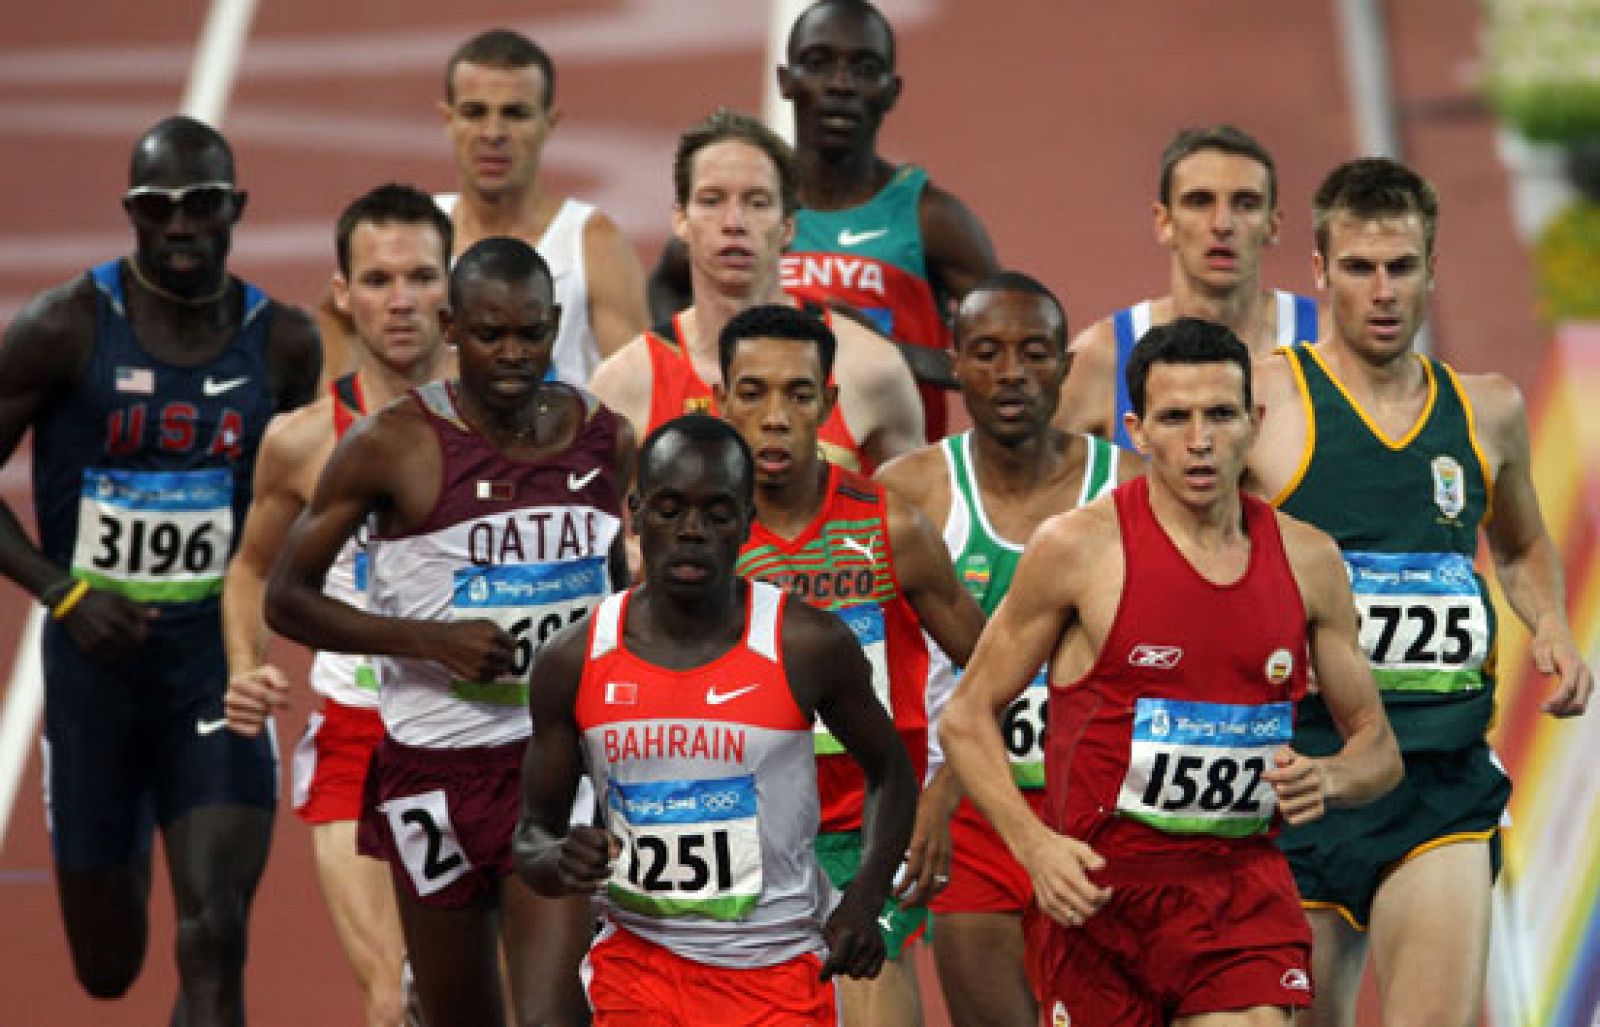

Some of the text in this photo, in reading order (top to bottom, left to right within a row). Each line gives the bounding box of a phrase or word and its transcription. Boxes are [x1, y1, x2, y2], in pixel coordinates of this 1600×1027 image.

[778, 257, 885, 297] ENYA
[107, 402, 243, 460] USA
[93, 514, 214, 575] 3196
[1358, 604, 1473, 664] 725
[604, 723, 747, 764] BAHRAIN
[1141, 752, 1264, 812] 1582
[401, 808, 464, 879] 2
